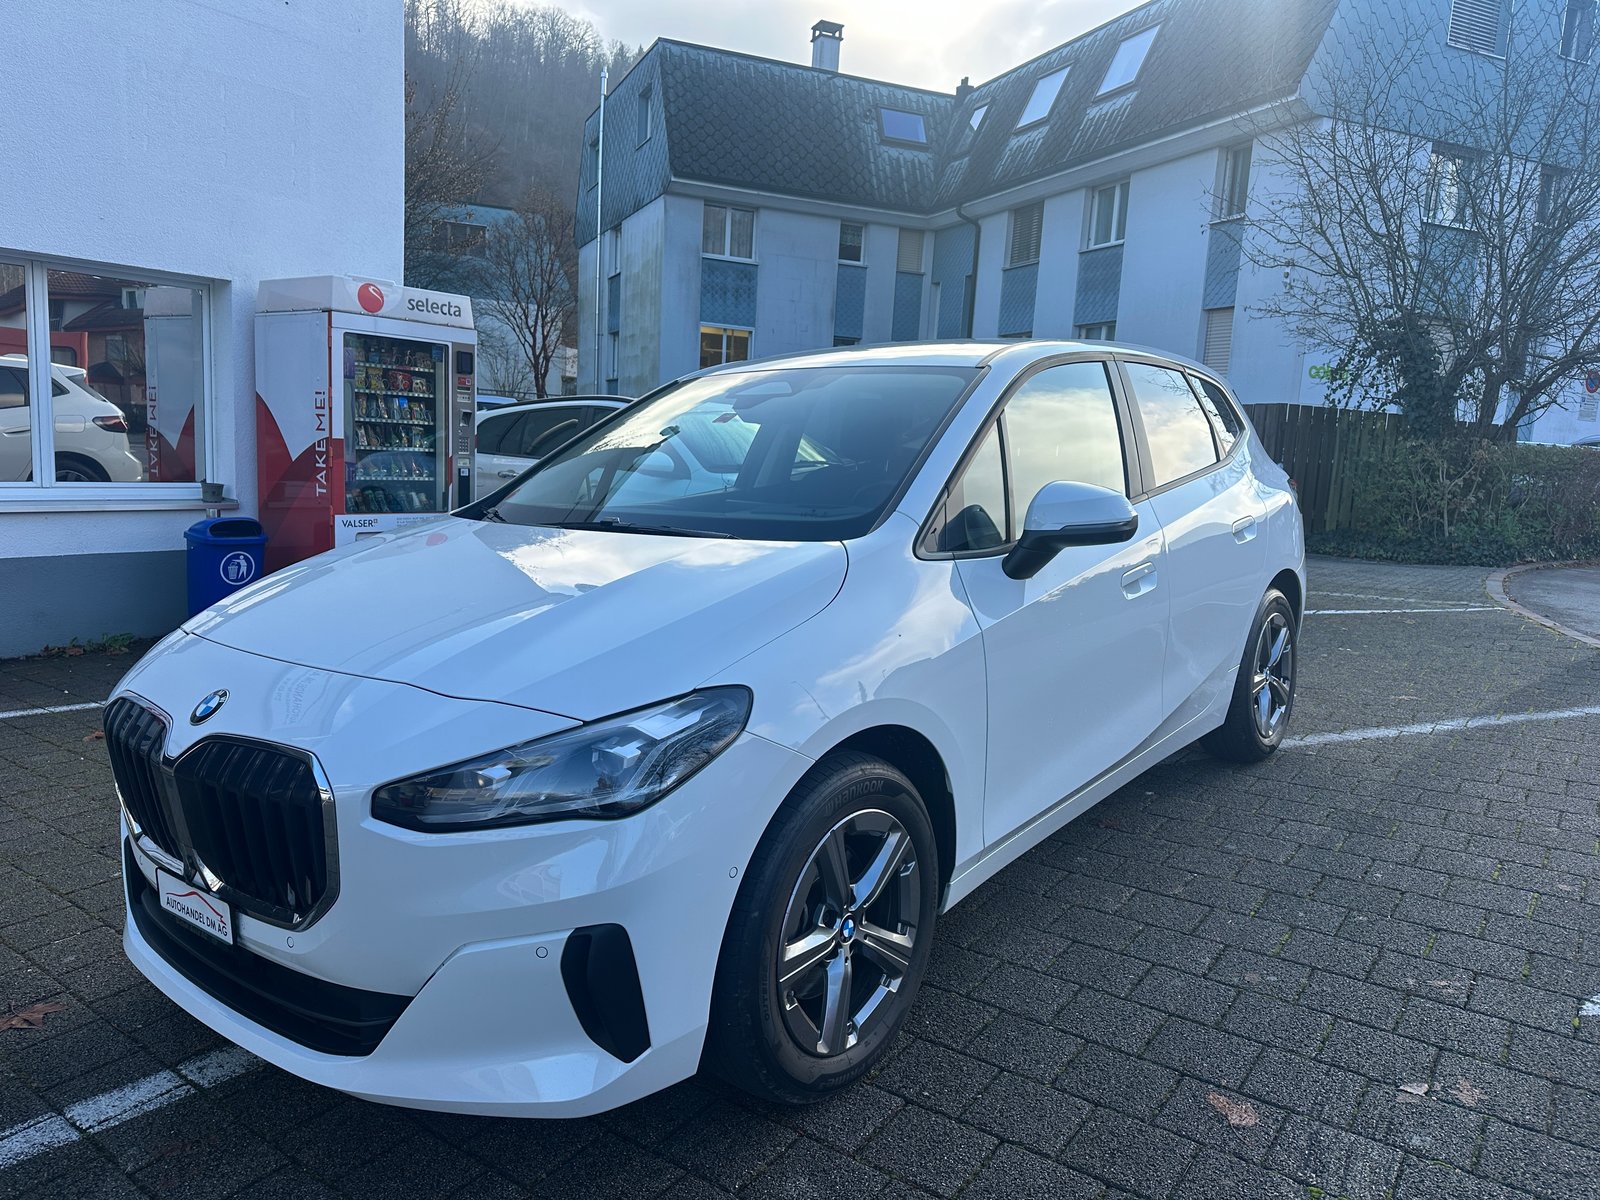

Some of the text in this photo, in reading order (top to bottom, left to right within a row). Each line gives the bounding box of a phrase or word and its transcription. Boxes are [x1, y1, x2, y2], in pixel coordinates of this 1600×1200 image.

[407, 298, 461, 317] selecta
[315, 391, 327, 497] TAKE ME!
[341, 519, 374, 528] VALSER
[166, 896, 228, 937] AUTOHANDEL DM AG
